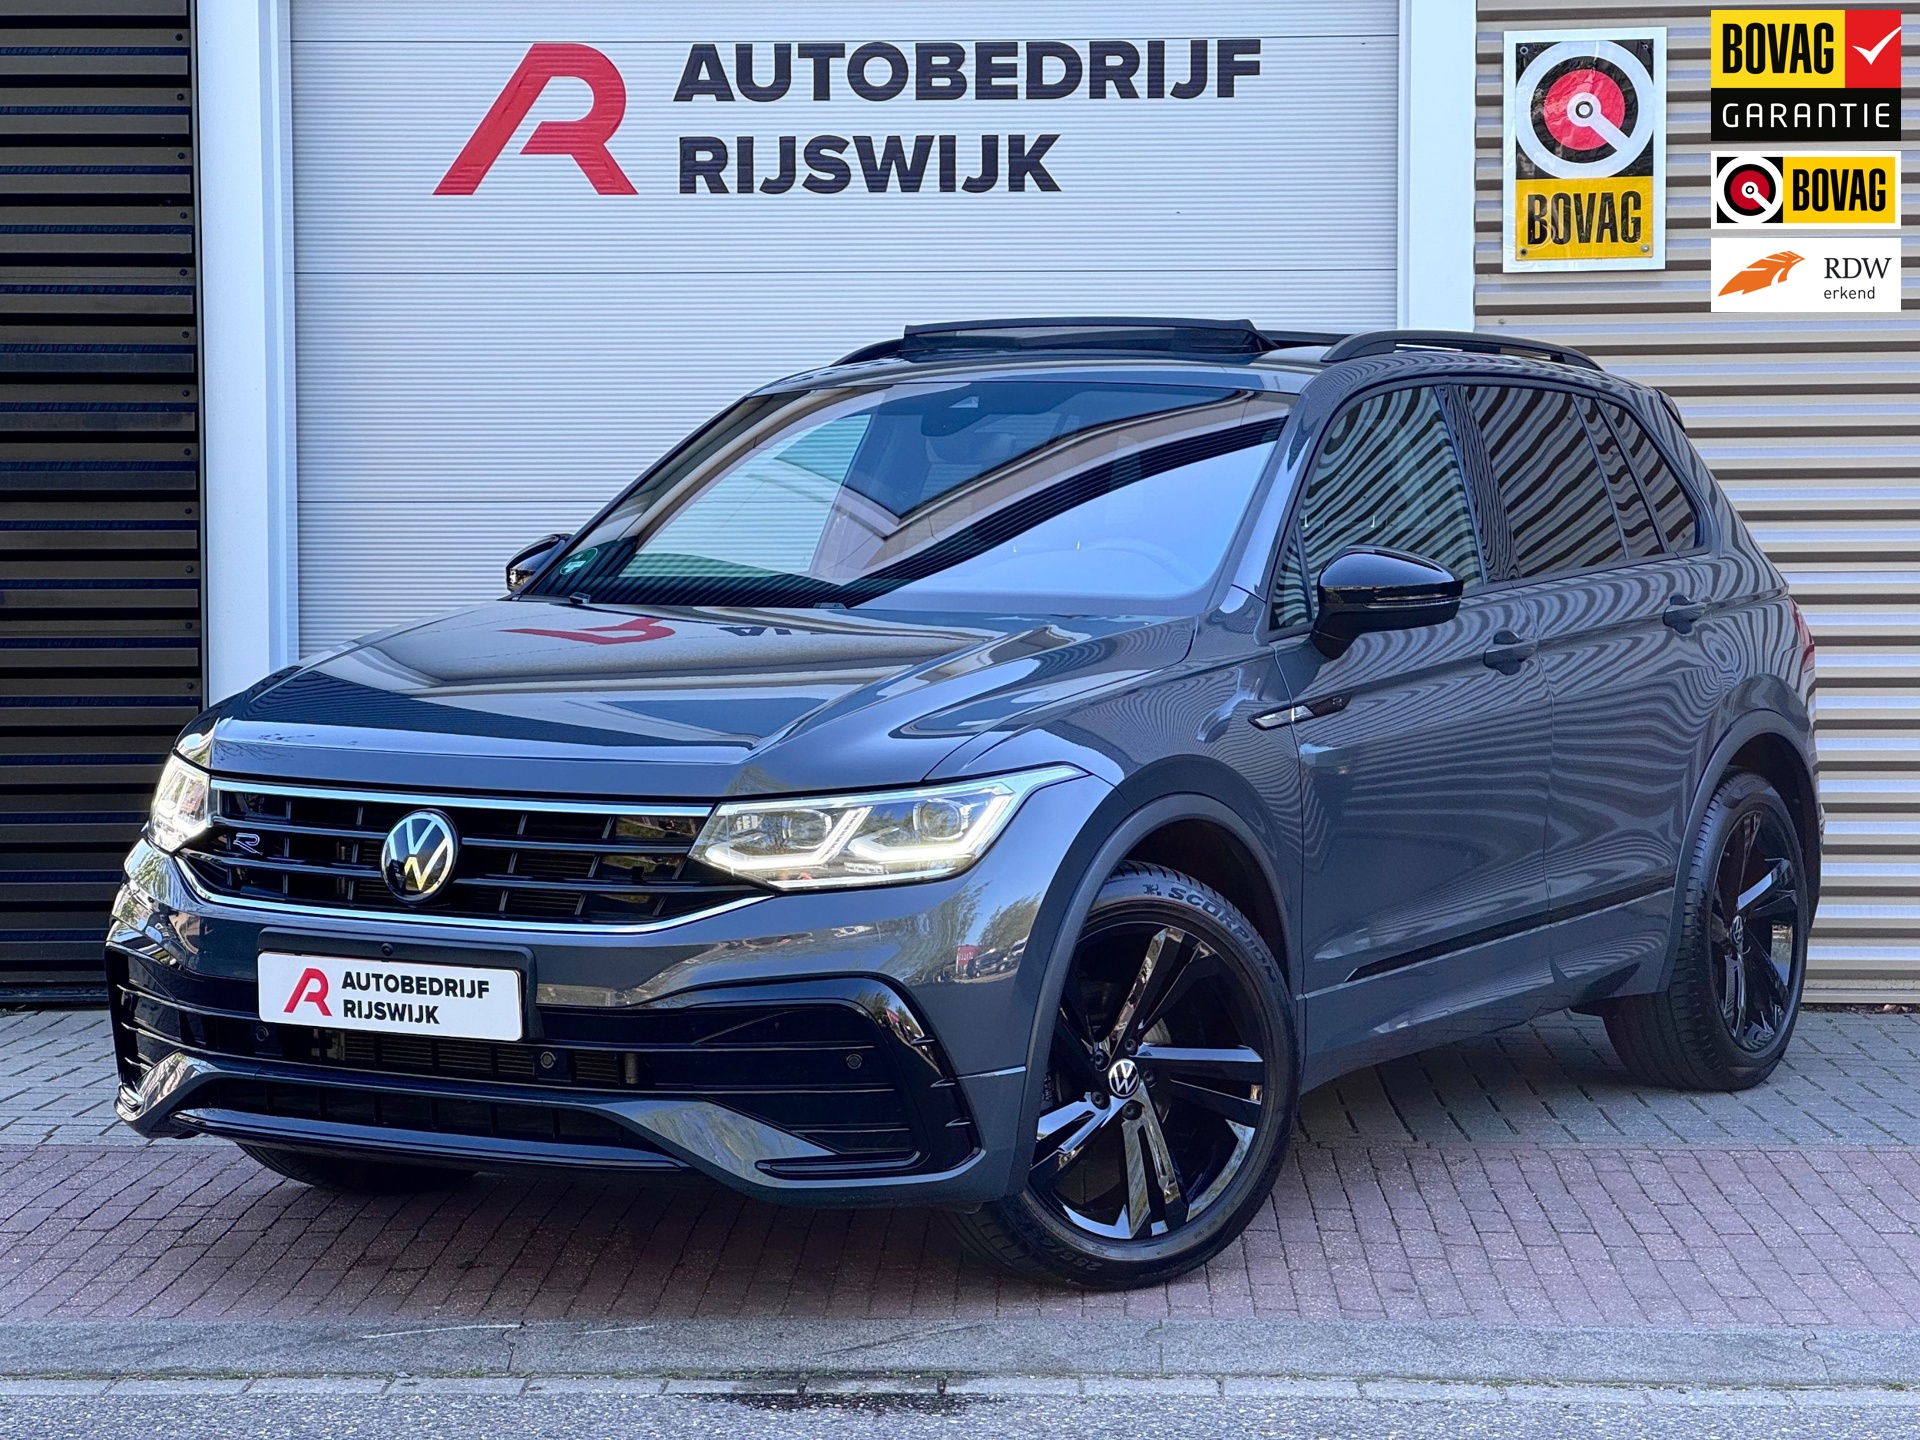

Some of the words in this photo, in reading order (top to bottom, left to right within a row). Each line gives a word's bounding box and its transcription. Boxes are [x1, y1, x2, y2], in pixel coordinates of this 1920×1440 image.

[672, 39, 1261, 102] AUTOBEDRIJF
[679, 133, 1062, 194] RIJSWIJK
[1527, 190, 1642, 246] BOVAG
[1168, 886, 1277, 984] SCORPION
[341, 971, 489, 998] AUTOBEDRIJF
[343, 1000, 439, 1025] RIJSWIJK
